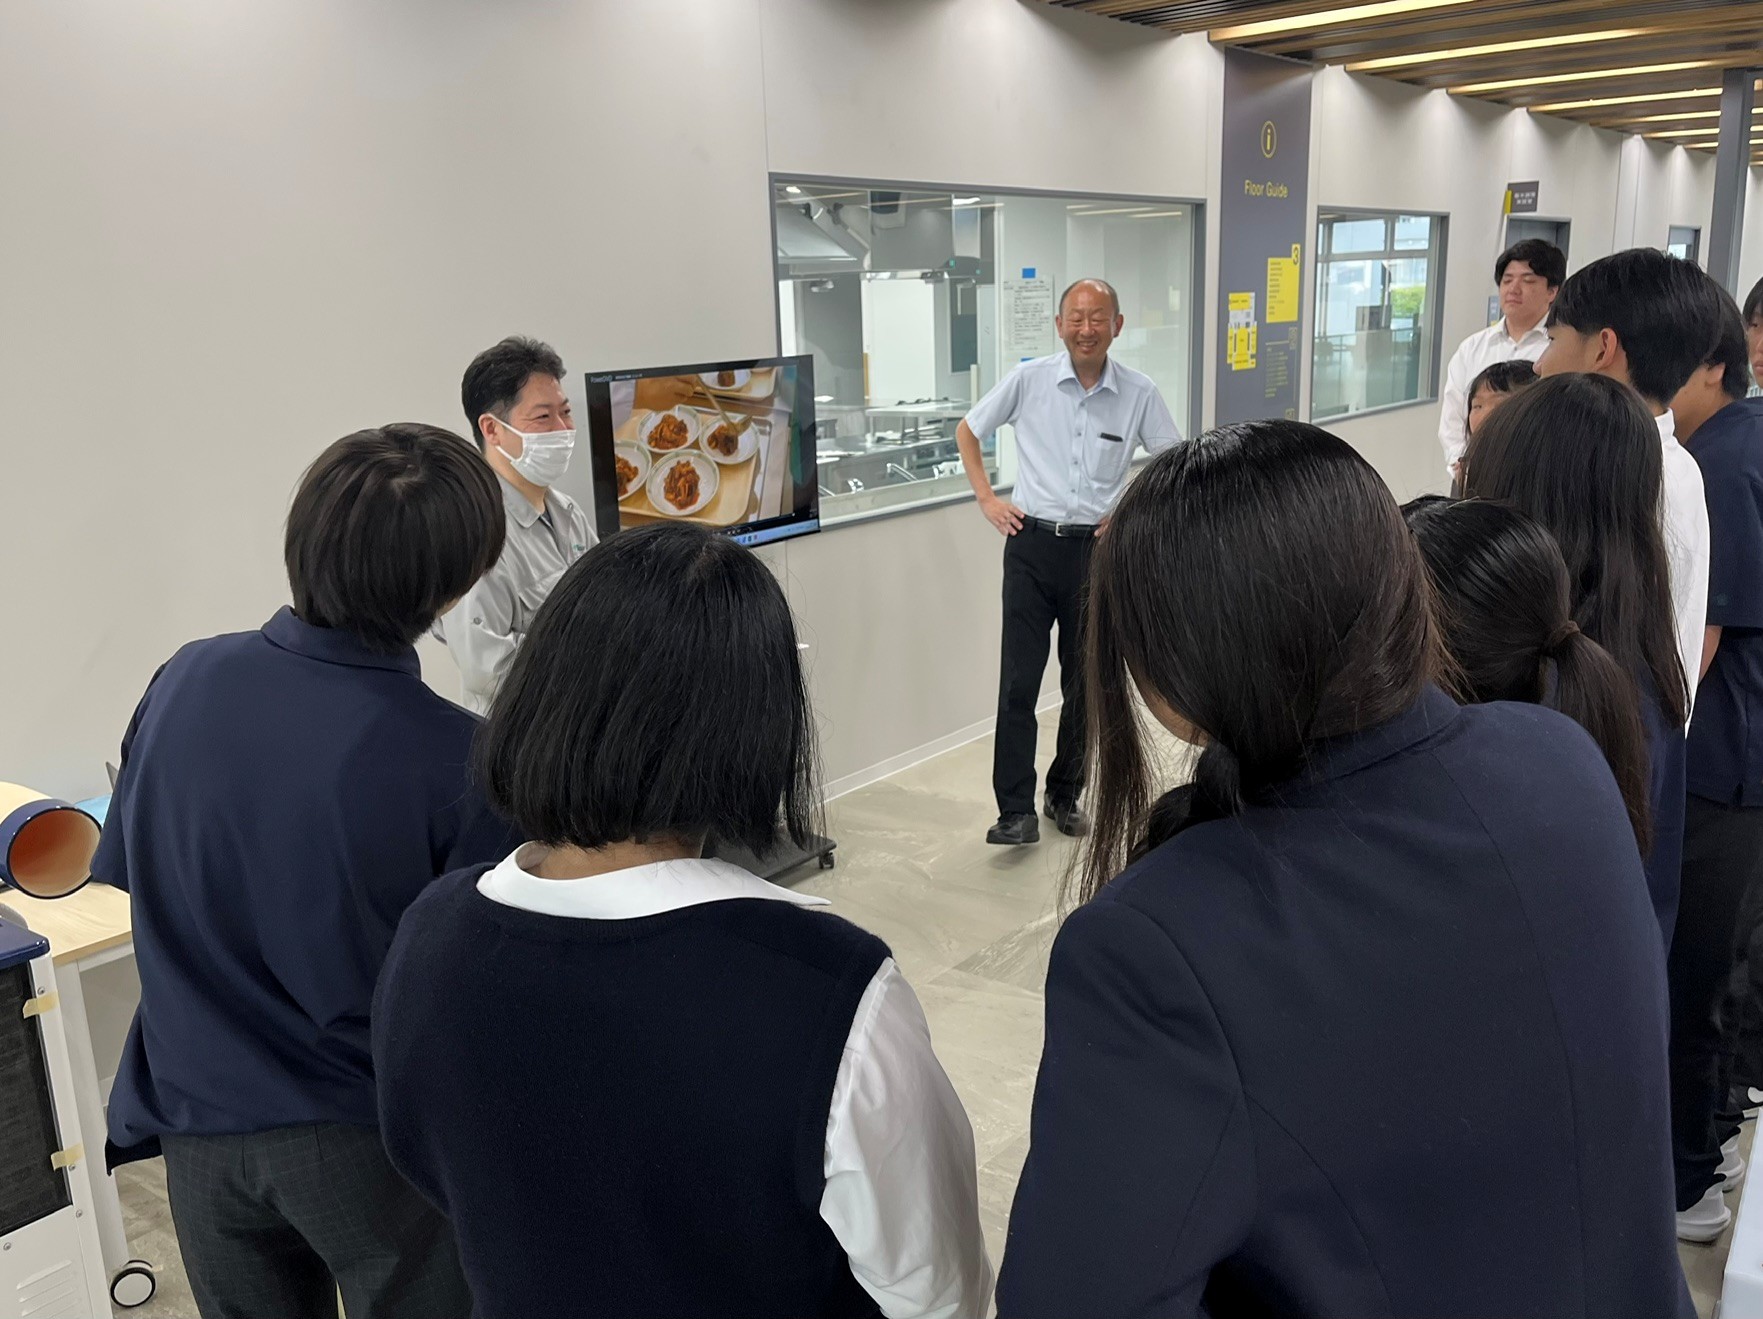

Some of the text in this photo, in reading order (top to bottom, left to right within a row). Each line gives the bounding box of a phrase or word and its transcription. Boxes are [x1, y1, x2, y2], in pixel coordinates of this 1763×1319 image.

[1244, 179, 1289, 198] Floor Guide
[1292, 246, 1299, 265] 3
